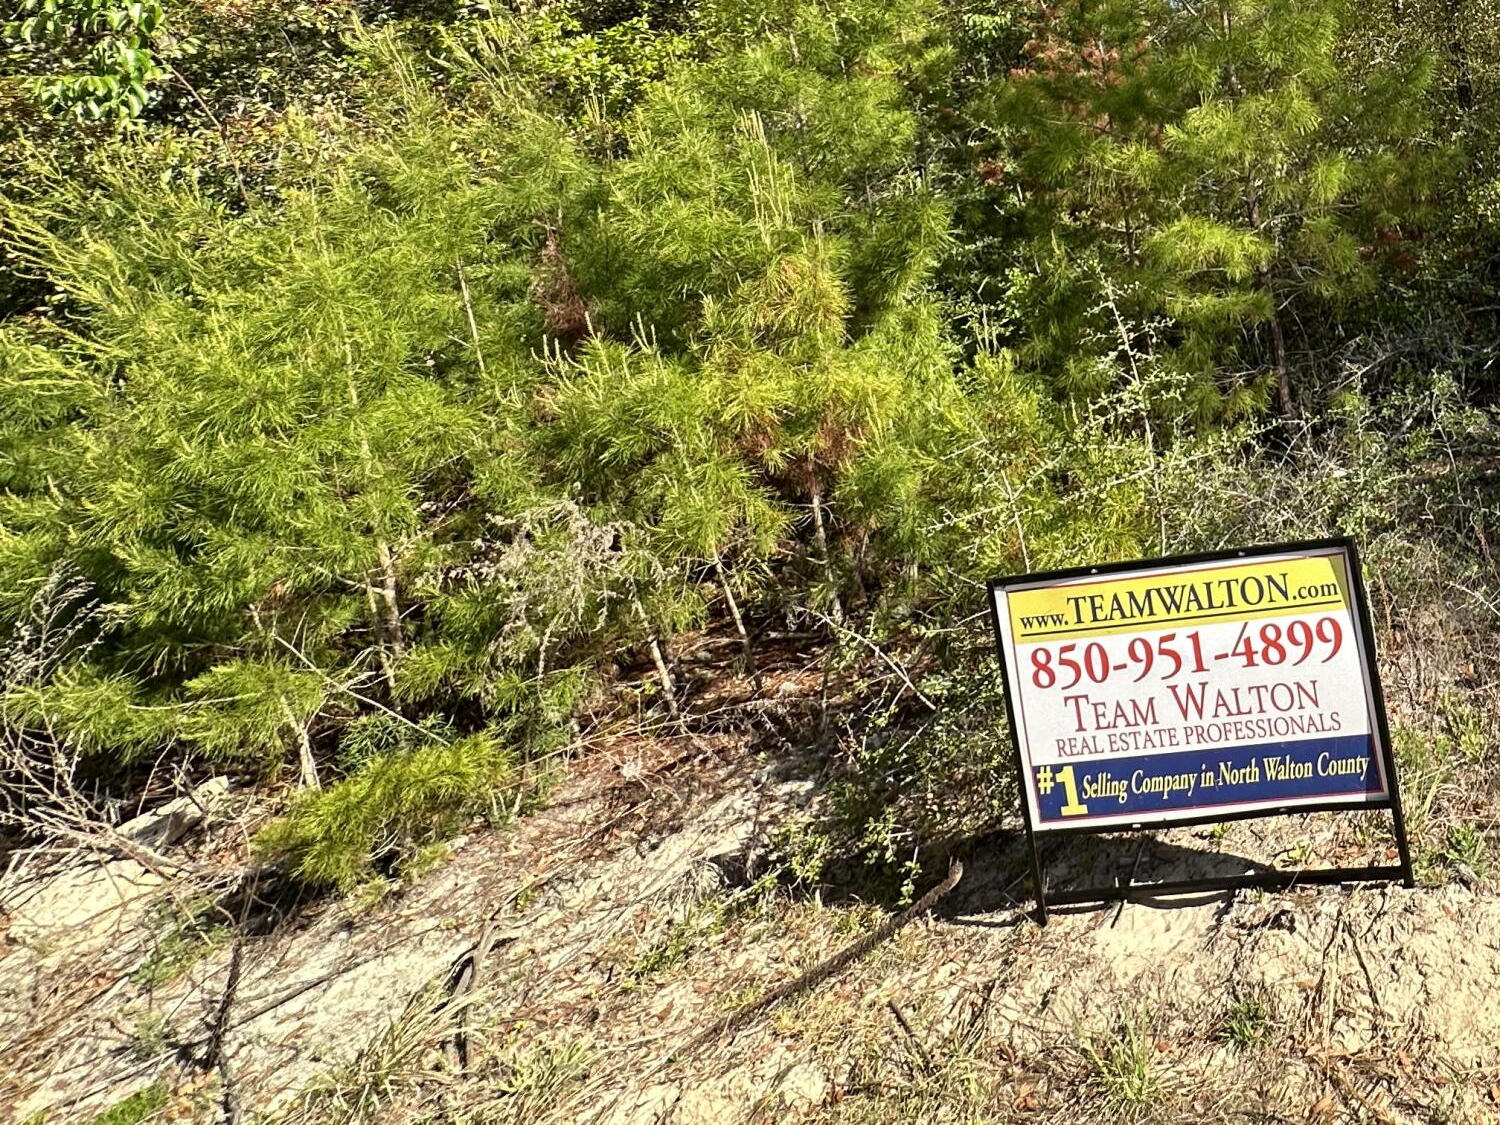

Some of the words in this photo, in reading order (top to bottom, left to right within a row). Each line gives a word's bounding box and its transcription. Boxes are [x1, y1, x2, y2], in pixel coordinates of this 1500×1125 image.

[1020, 574, 1339, 630] www.TEAMWALTON.com
[1031, 617, 1343, 690] 850-951-4899
[1057, 735, 1104, 758] REAL
[1109, 728, 1179, 752] ESTATE
[1184, 712, 1341, 744] PROFESSIONALS
[1037, 765, 1088, 816] #1
[1082, 774, 1127, 804] Selling
[1131, 769, 1197, 797] Company
[1200, 764, 1214, 786] in
[1218, 761, 1259, 786] North
[1263, 757, 1312, 782] Walton
[1317, 752, 1370, 779] County
